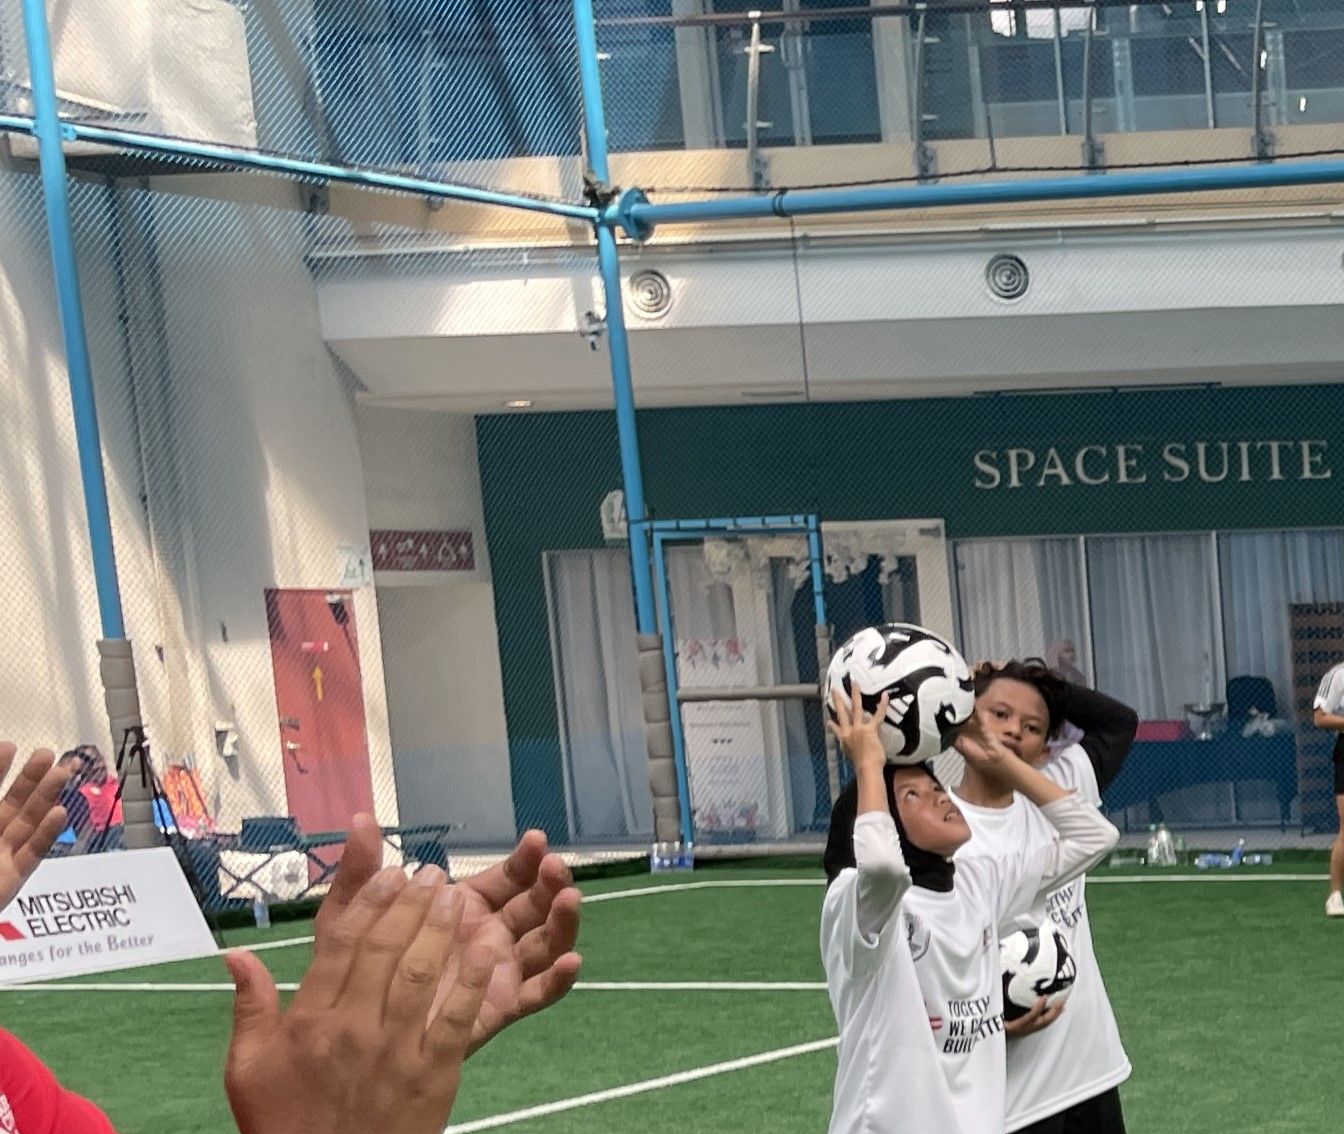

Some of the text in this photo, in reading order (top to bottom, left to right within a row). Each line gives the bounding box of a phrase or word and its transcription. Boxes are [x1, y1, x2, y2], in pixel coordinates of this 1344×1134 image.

[973, 440, 1332, 489] SPACE SUITE
[17, 884, 137, 917] MITSUBISHI
[26, 907, 131, 938] ELECTRIC
[50, 944, 73, 962] for
[79, 940, 102, 955] the
[107, 935, 155, 951] Better
